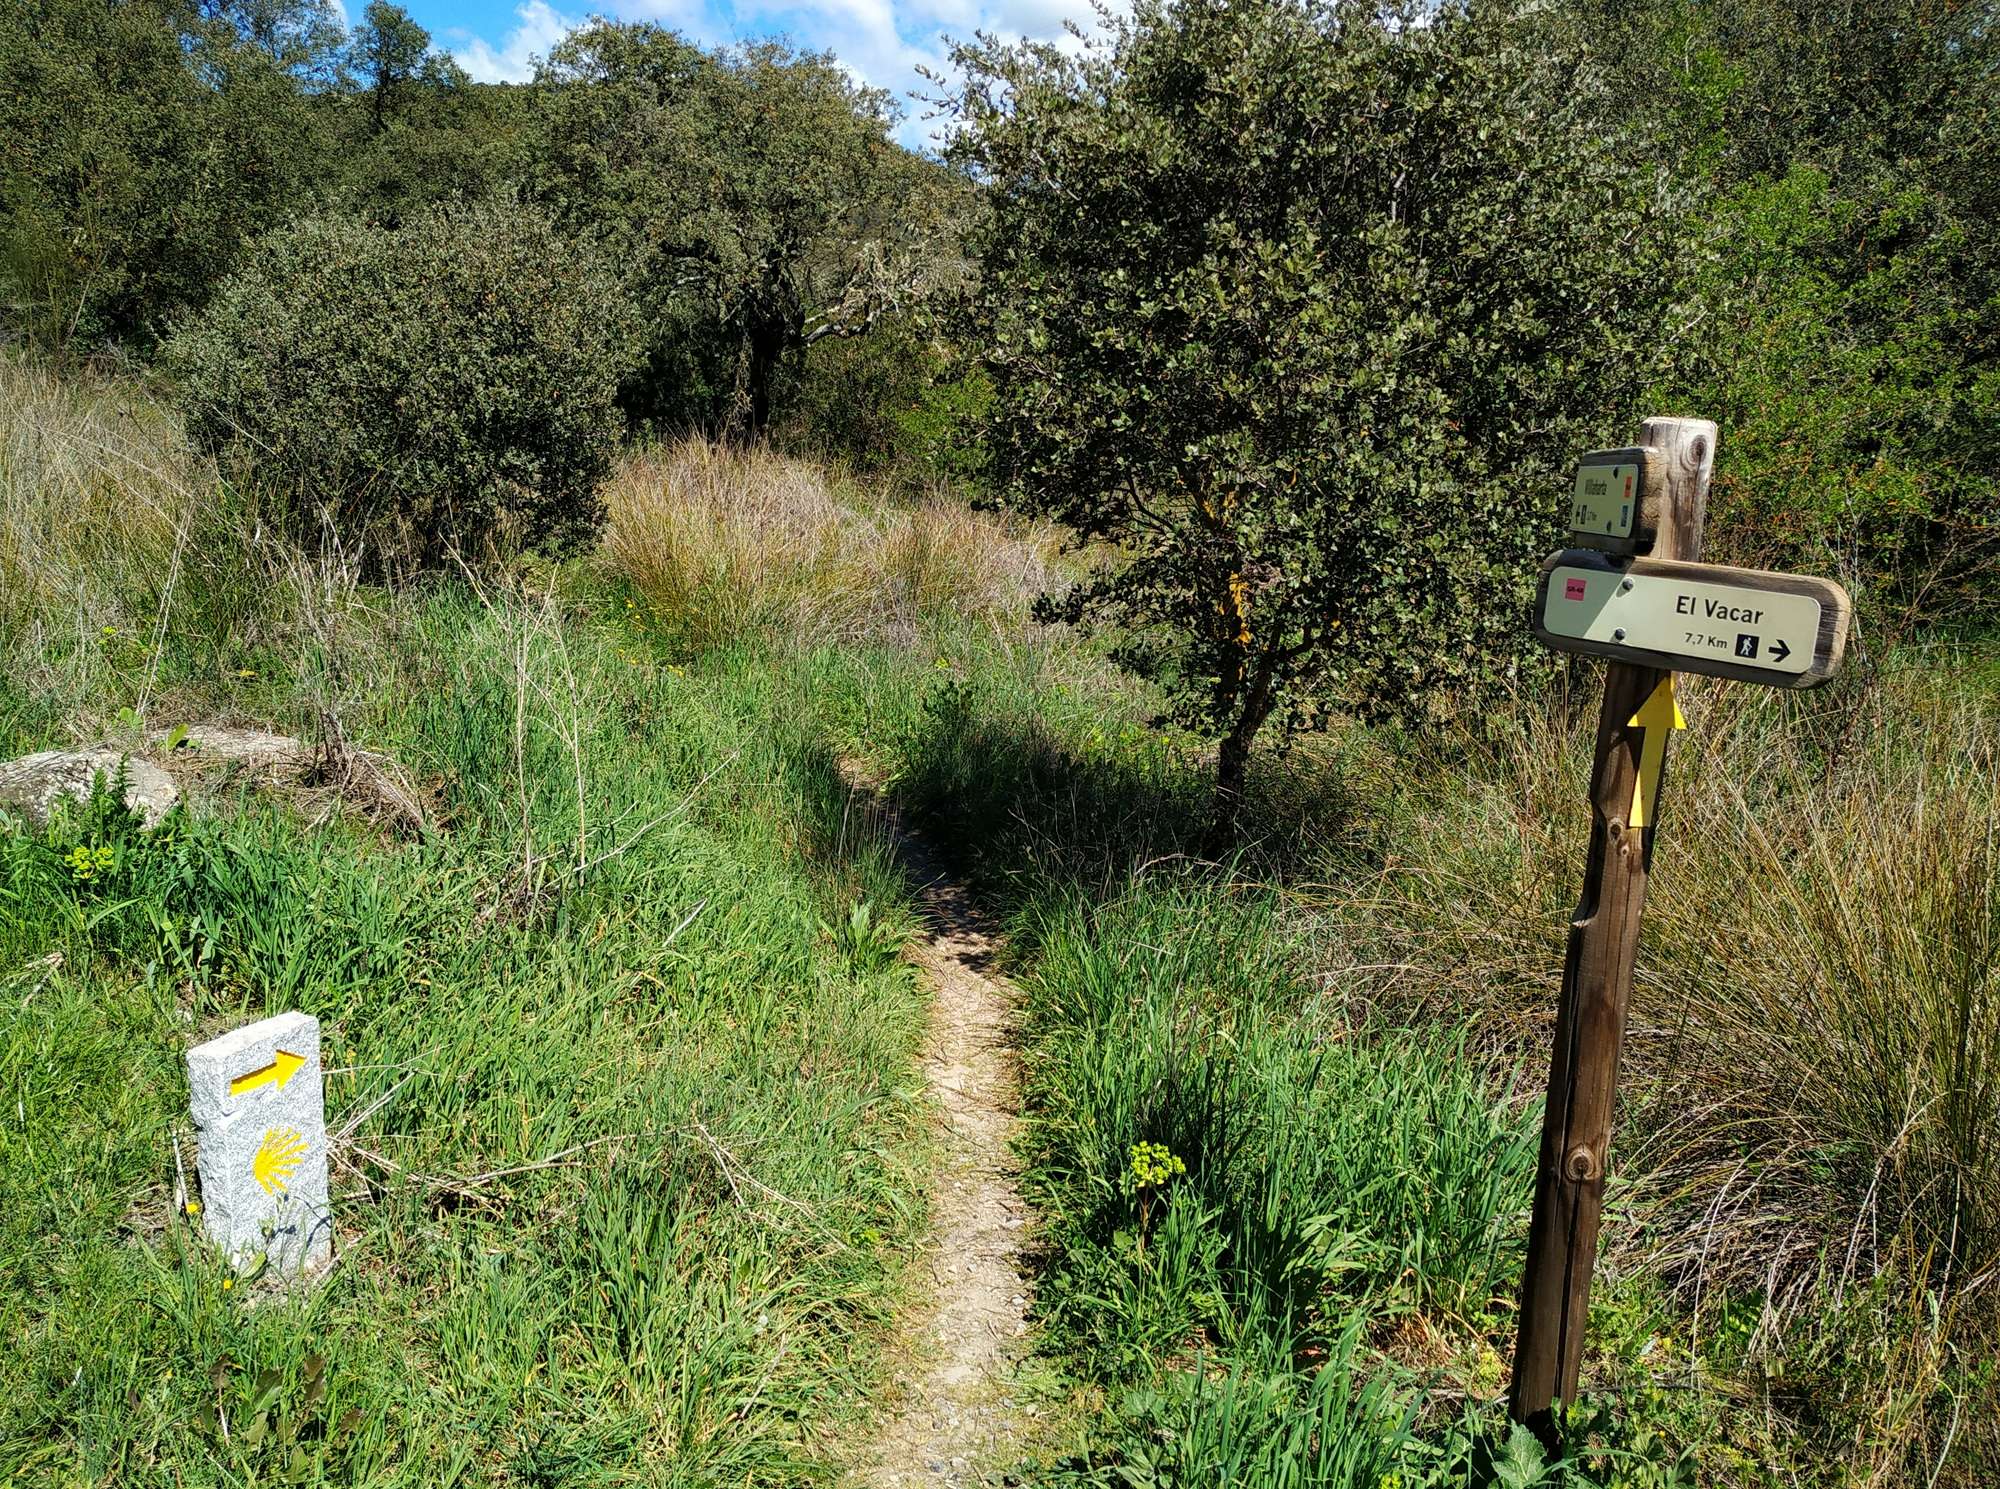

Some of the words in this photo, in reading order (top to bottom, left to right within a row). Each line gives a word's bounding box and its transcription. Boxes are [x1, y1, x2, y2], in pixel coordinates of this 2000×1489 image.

[1676, 595, 1696, 614] El
[1705, 598, 1764, 624] Vacar
[1684, 632, 1703, 646] 7,7
[1707, 636, 1728, 649] Km
